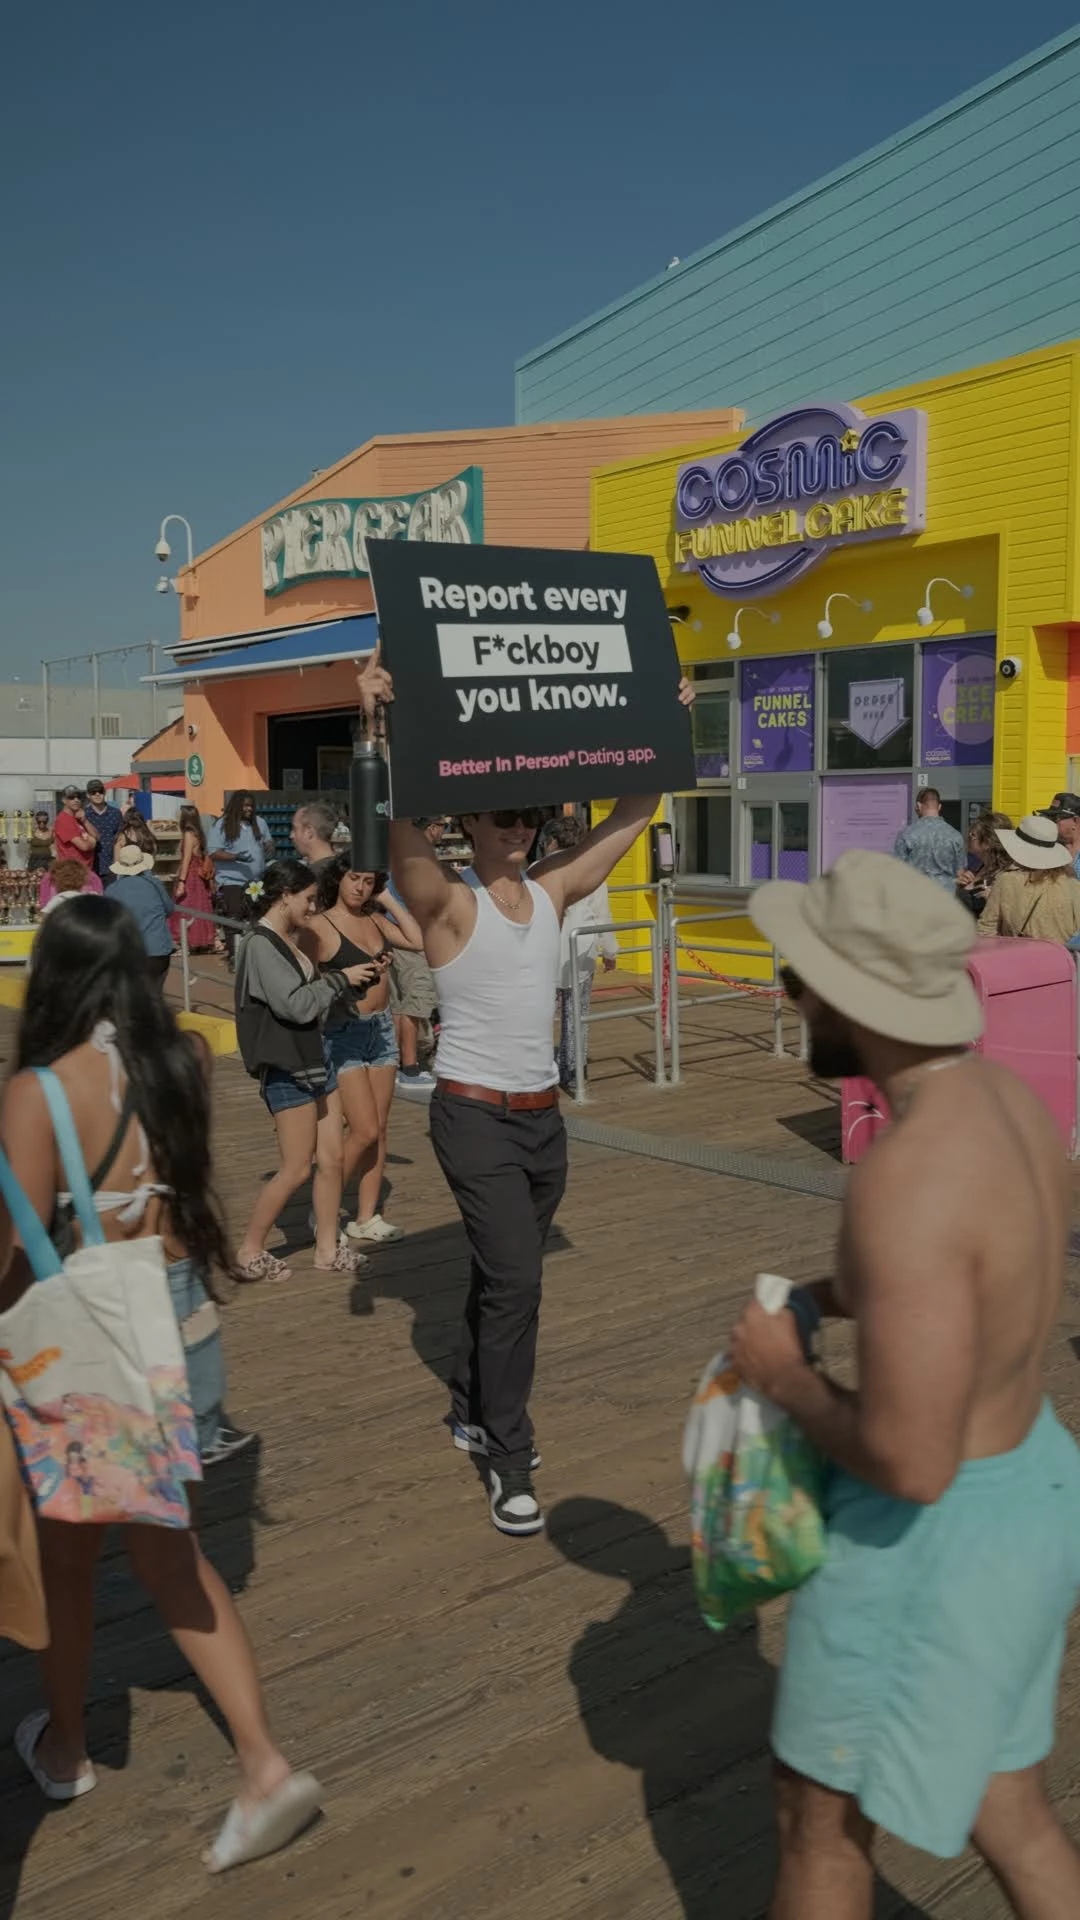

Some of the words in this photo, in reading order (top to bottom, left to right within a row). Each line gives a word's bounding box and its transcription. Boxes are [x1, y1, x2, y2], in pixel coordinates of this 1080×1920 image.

[674, 508, 804, 564] FUNNEL
[804, 487, 910, 540] CAKE
[418, 576, 538, 618] Report
[543, 586, 627, 619] every
[456, 687, 521, 723] you
[528, 678, 628, 711] know.
[753, 693, 812, 711] FUNNEL
[942, 704, 993, 725] CREA
[757, 710, 807, 729] CAKES
[439, 759, 492, 777] Better
[495, 756, 512, 772] In
[577, 747, 625, 766] Dating
[627, 747, 657, 764] app.
